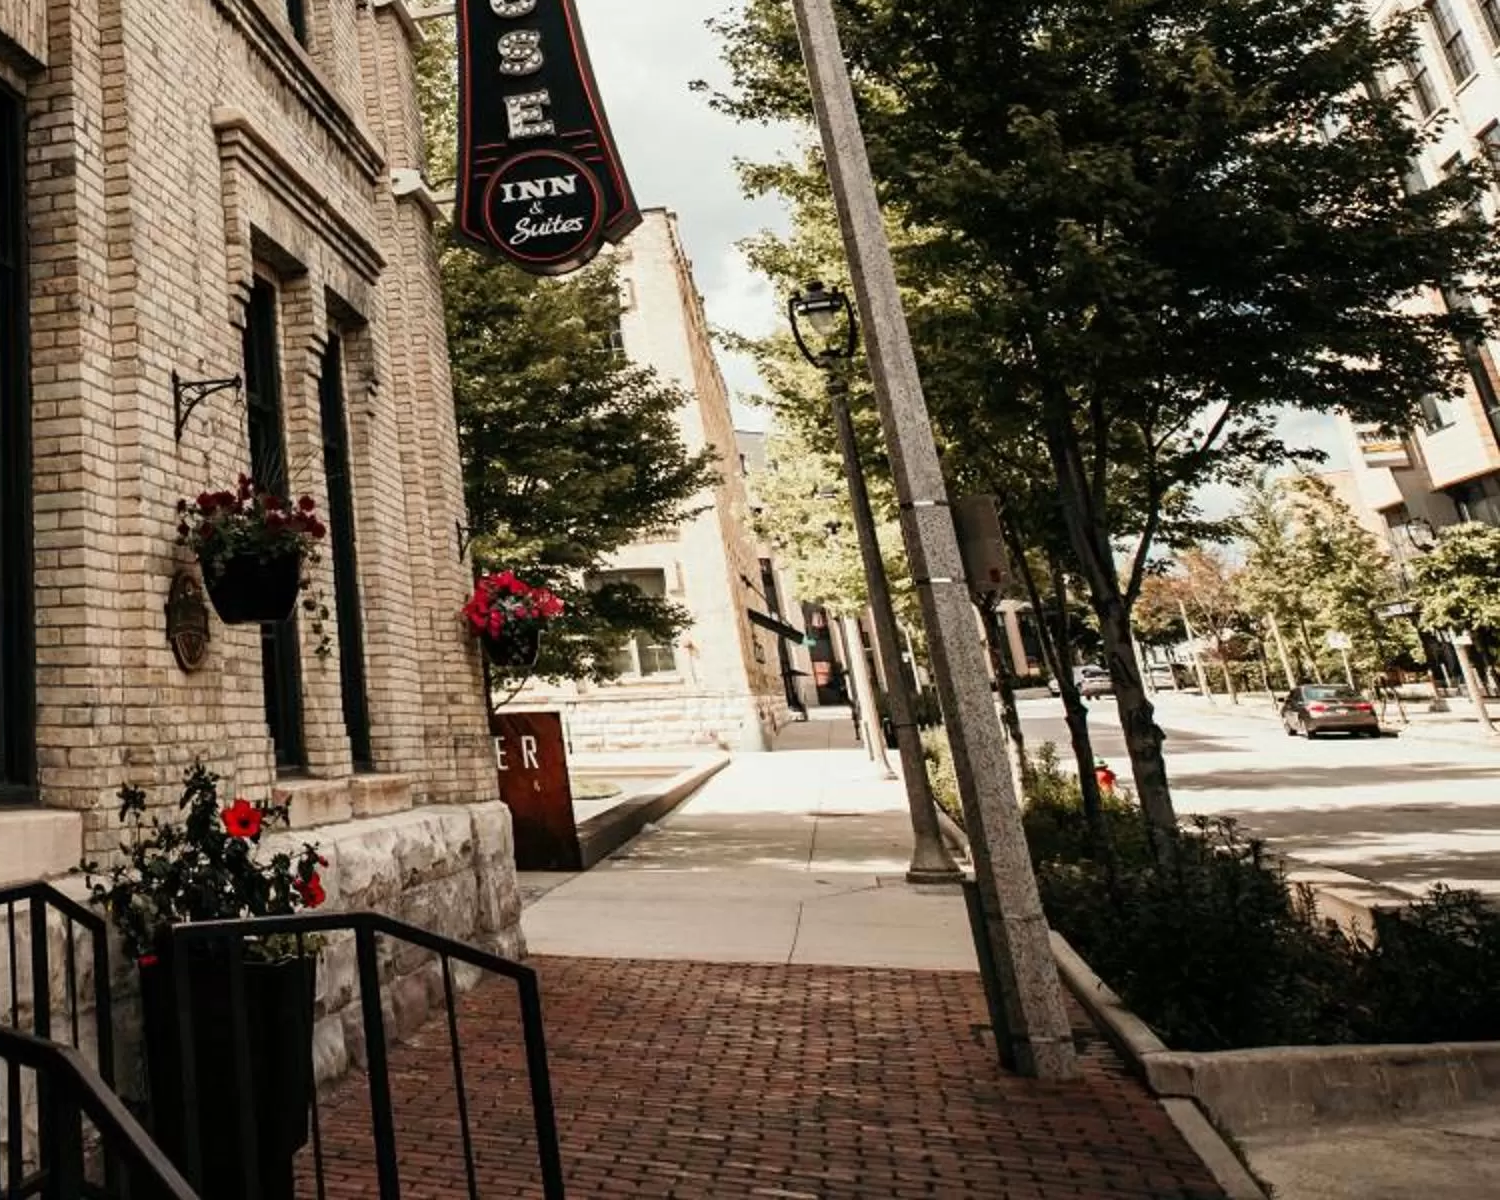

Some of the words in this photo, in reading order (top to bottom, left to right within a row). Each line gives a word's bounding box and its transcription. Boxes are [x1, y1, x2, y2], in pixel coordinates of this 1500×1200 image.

[500, 174, 578, 203] INN
[529, 201, 543, 215] &
[510, 214, 585, 245] Suites
